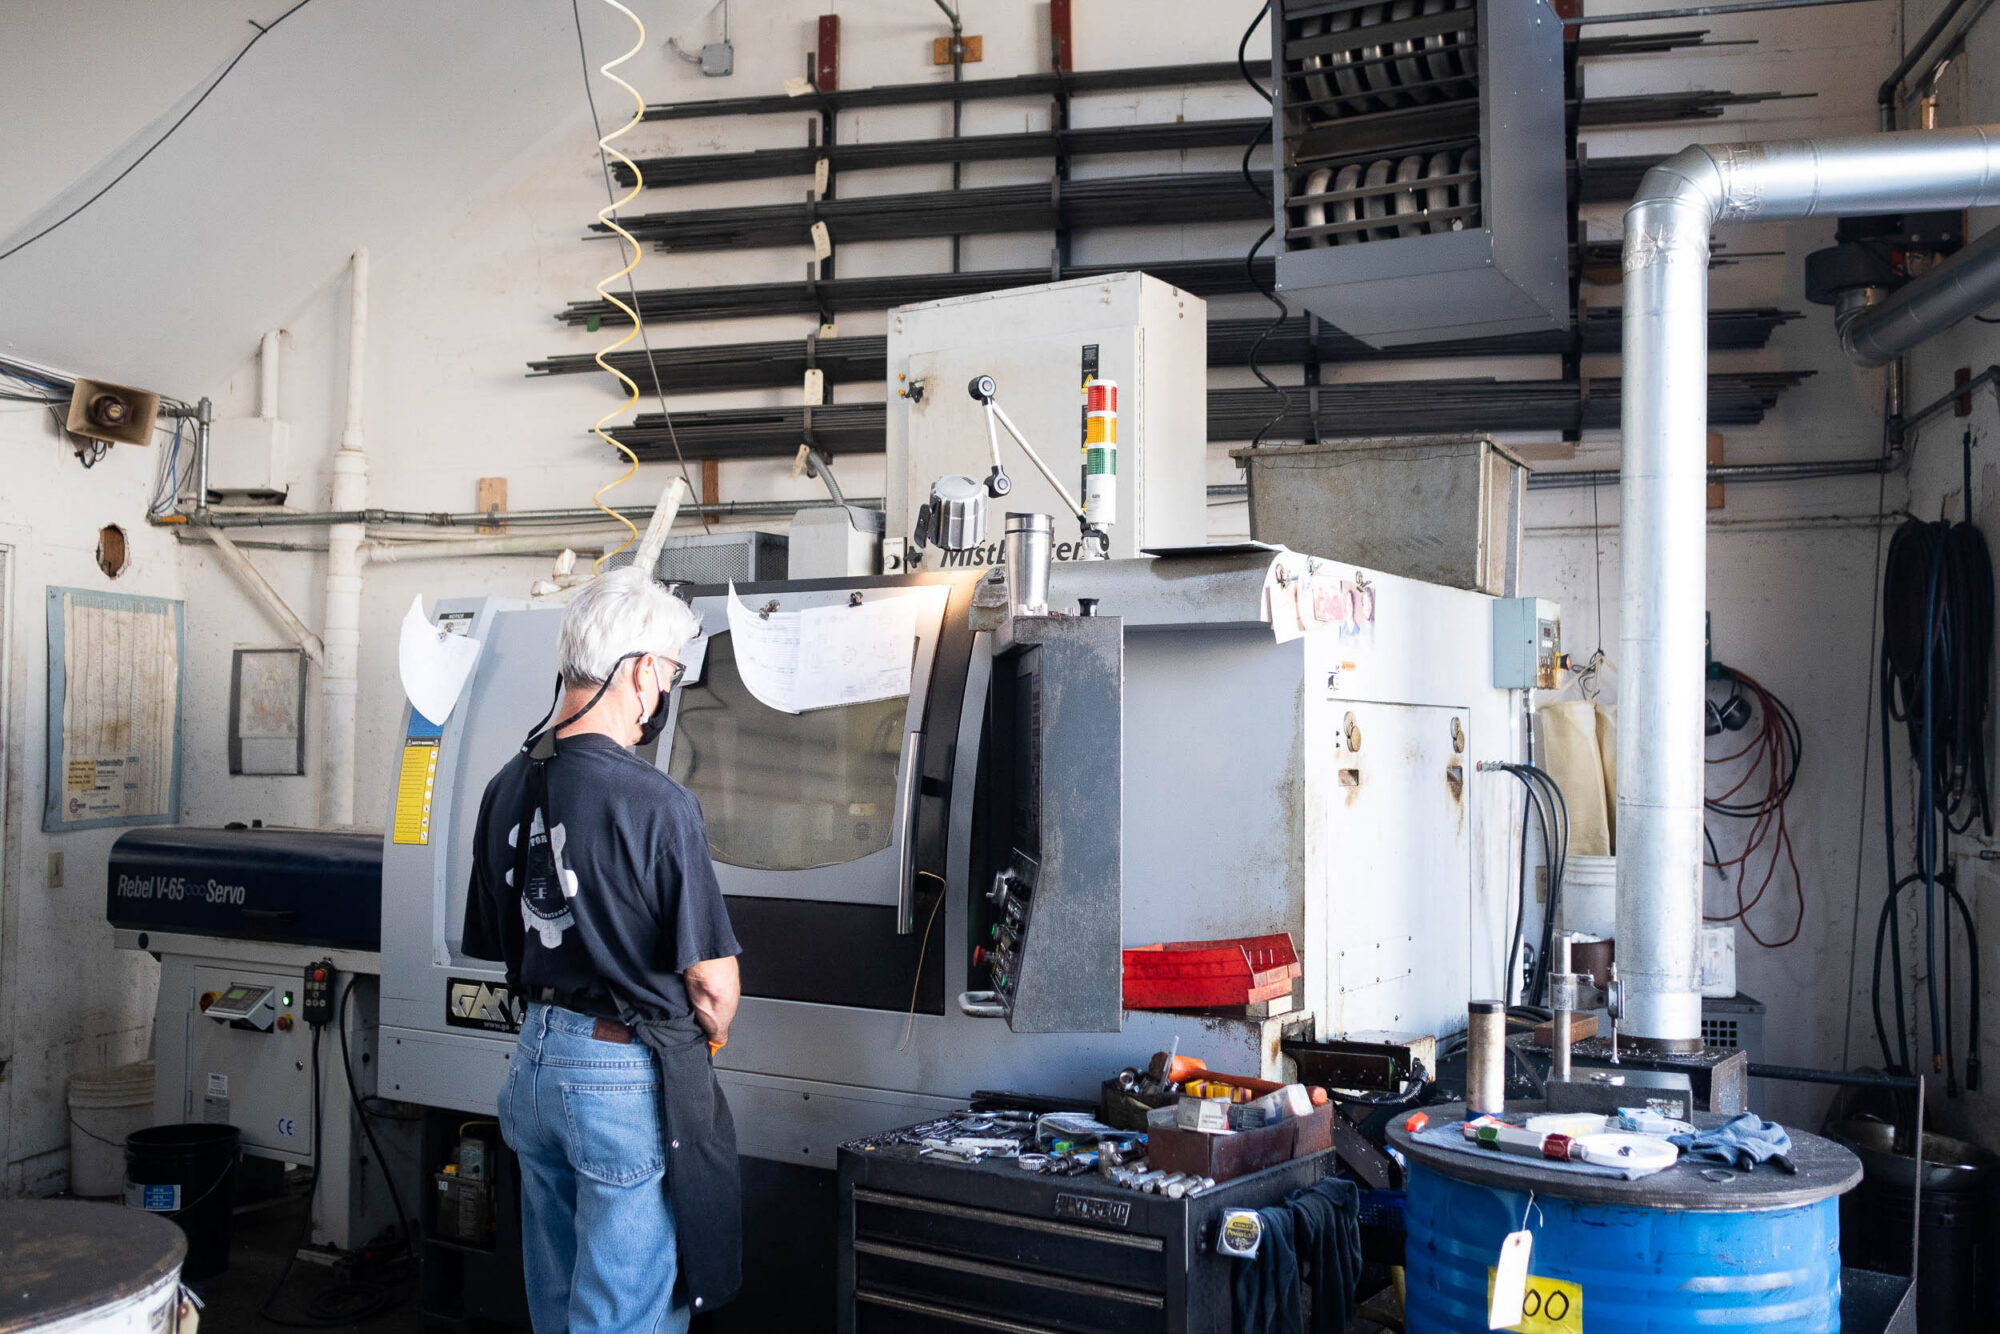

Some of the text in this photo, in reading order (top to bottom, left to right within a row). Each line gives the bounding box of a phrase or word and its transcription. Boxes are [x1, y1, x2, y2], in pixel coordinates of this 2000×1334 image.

[117, 874, 246, 905] Rebel V-65 Servo
